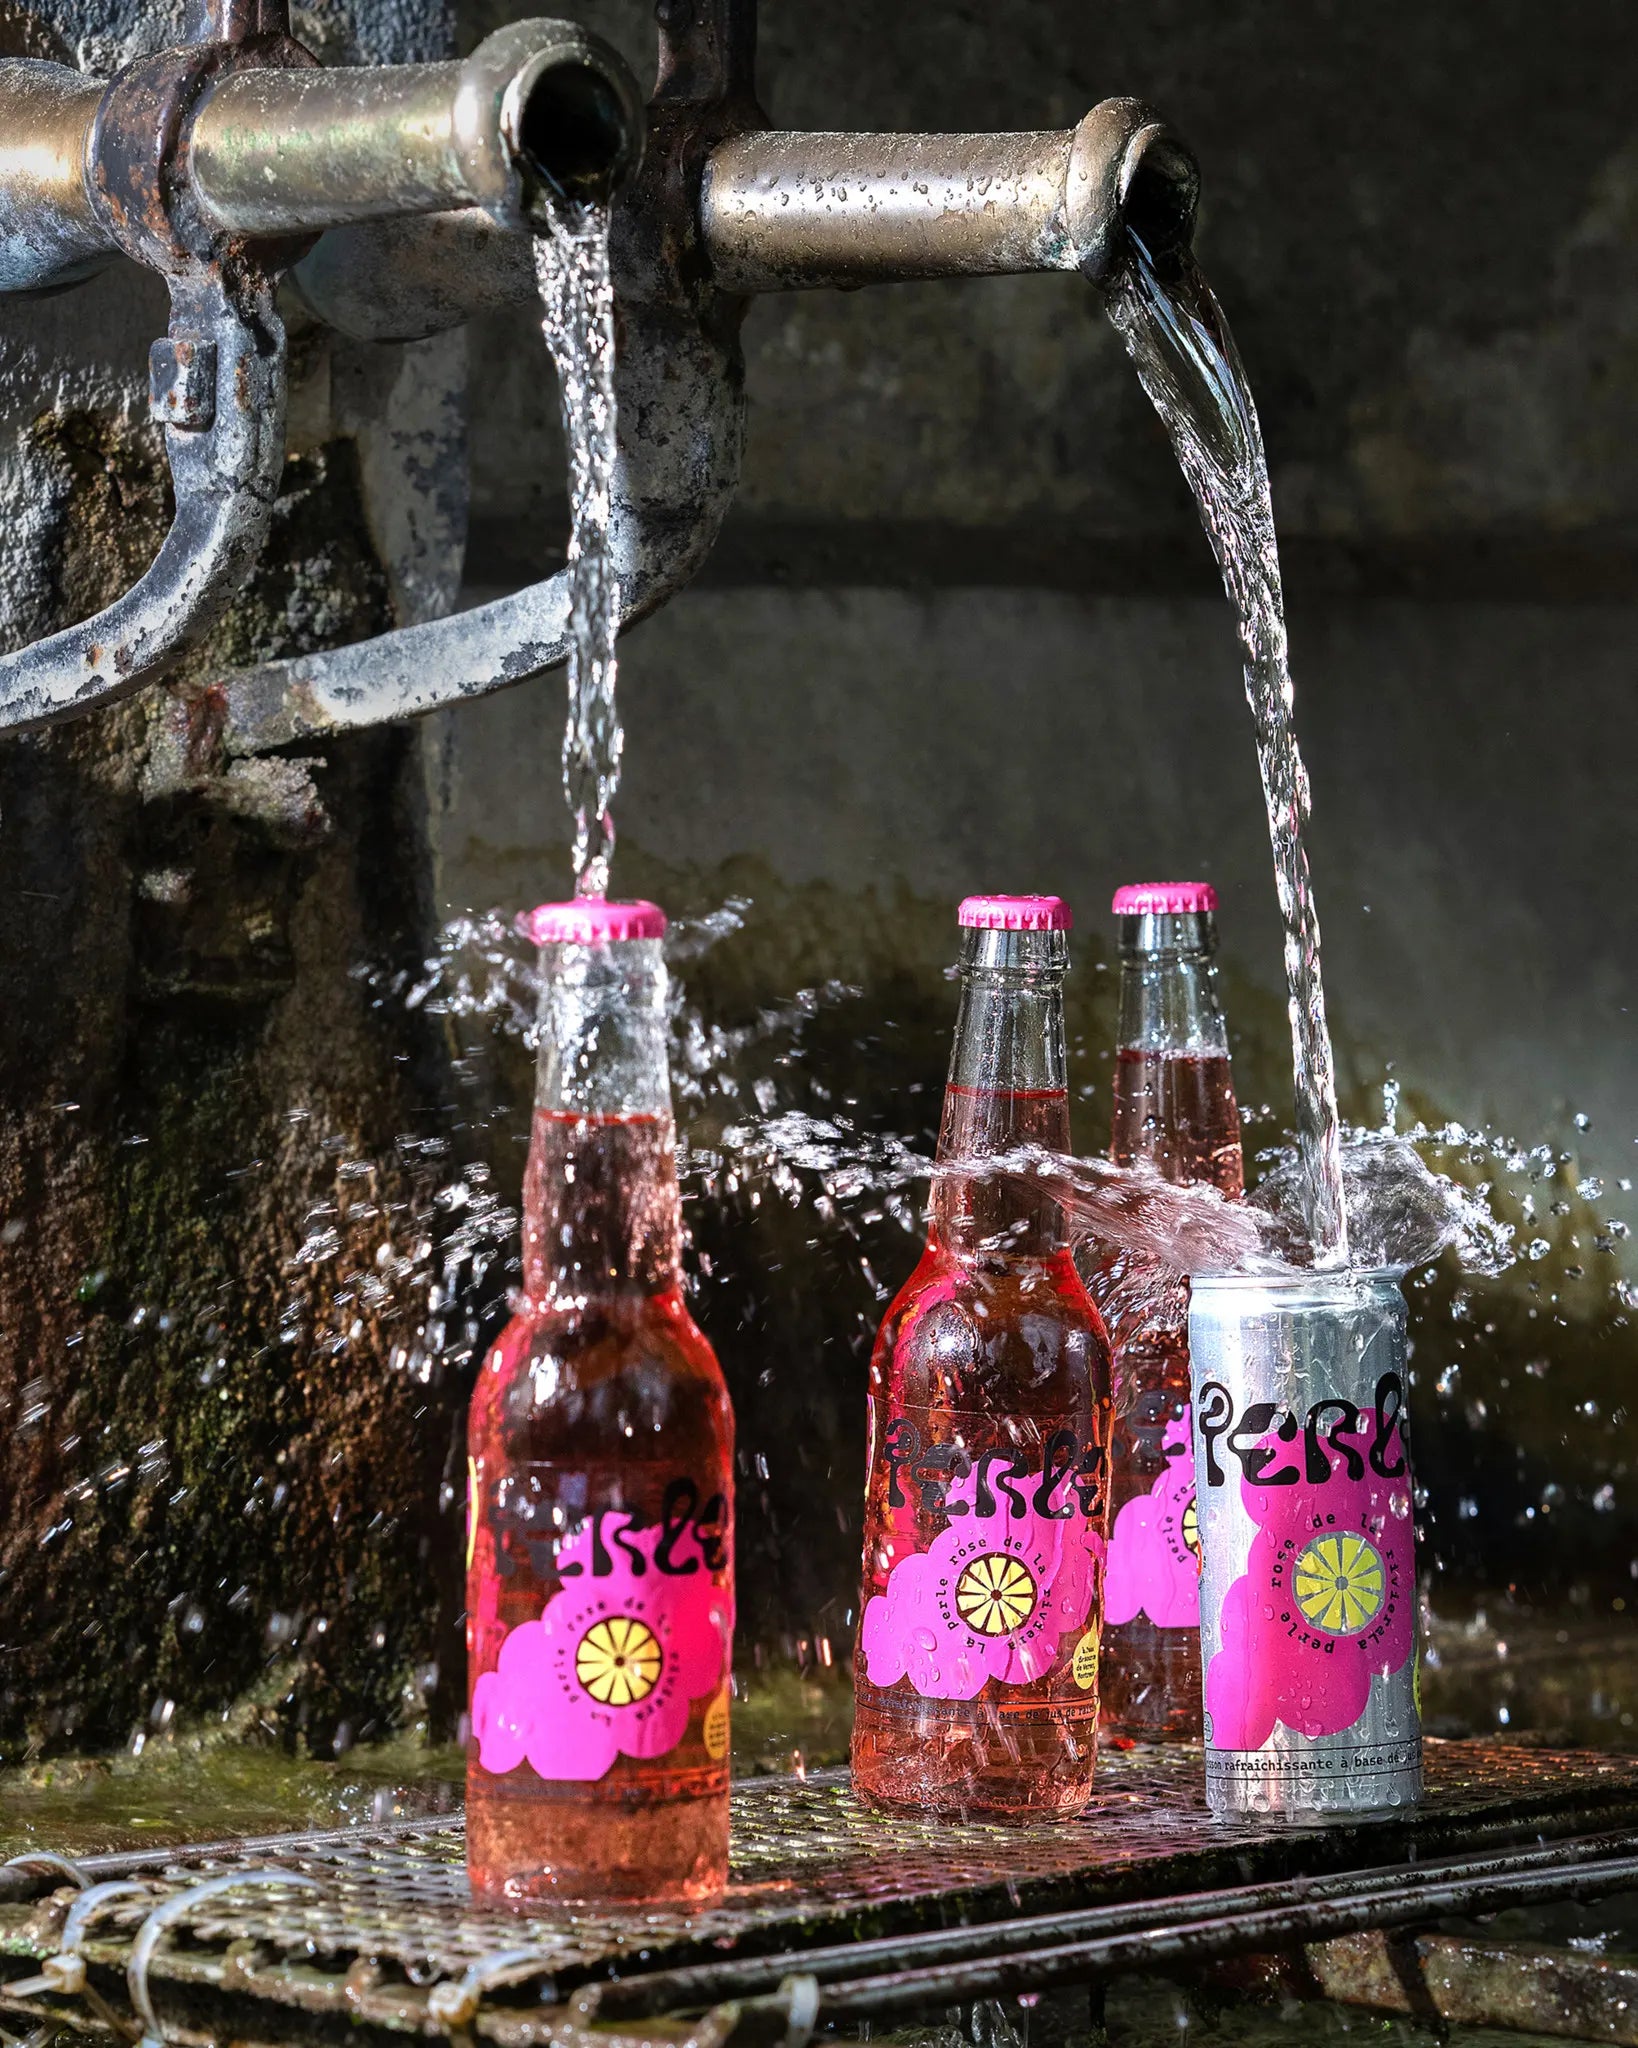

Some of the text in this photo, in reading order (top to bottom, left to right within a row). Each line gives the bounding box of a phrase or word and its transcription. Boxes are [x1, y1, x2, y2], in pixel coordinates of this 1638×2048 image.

[1311, 1512, 1337, 1529] de
[948, 1538, 987, 1567] rose
[1003, 1535, 1023, 1551] de
[1033, 1553, 1046, 1576] la
[1271, 1538, 1296, 1589] rose
[935, 1578, 960, 1631] perle
[1280, 1611, 1336, 1654] perle
[965, 1636, 987, 1655] La
[1225, 1757, 1333, 1772] rafraîchissante
[1340, 1756, 1349, 1769] à
[1354, 1755, 1384, 1768] base
